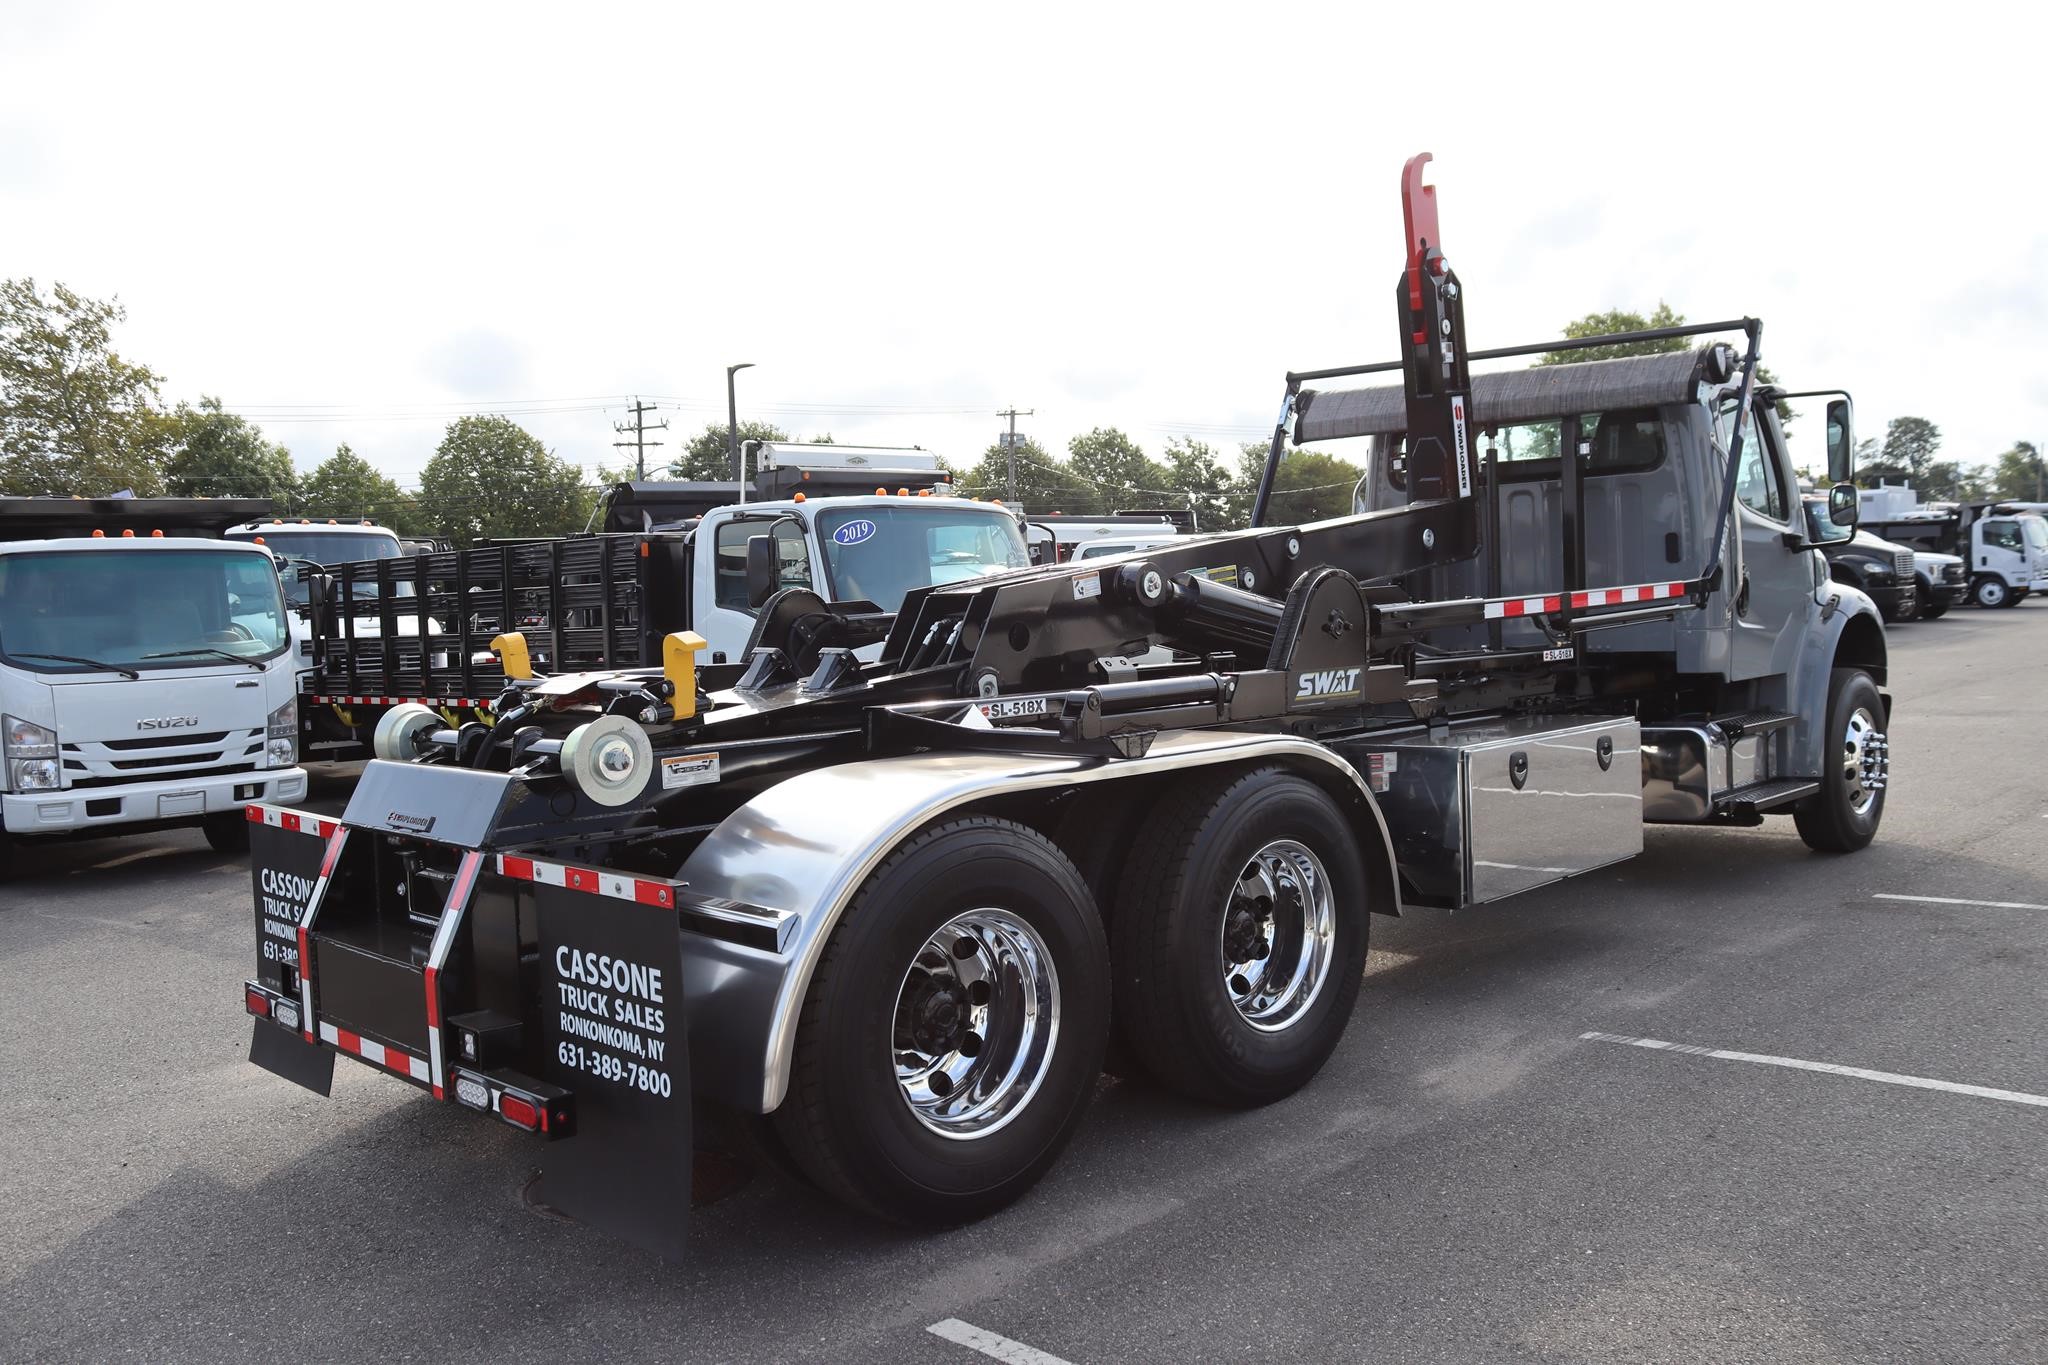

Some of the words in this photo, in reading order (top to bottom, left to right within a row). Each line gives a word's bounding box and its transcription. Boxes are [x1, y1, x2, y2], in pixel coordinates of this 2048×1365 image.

[1456, 423, 1468, 489] SWAPLOADER
[842, 522, 868, 543] 2019
[1297, 668, 1361, 696] SWAT
[136, 716, 199, 731] ISUZU
[261, 868, 314, 903] CASSON
[262, 896, 292, 921] TRUCK
[556, 945, 664, 1004] CASSONE
[558, 982, 610, 1018] TRUCK
[614, 999, 665, 1034] SALES
[560, 1012, 646, 1059] RONKONKOMA,
[648, 1038, 665, 1062] NY
[558, 1041, 672, 1098] 631-389-7800
